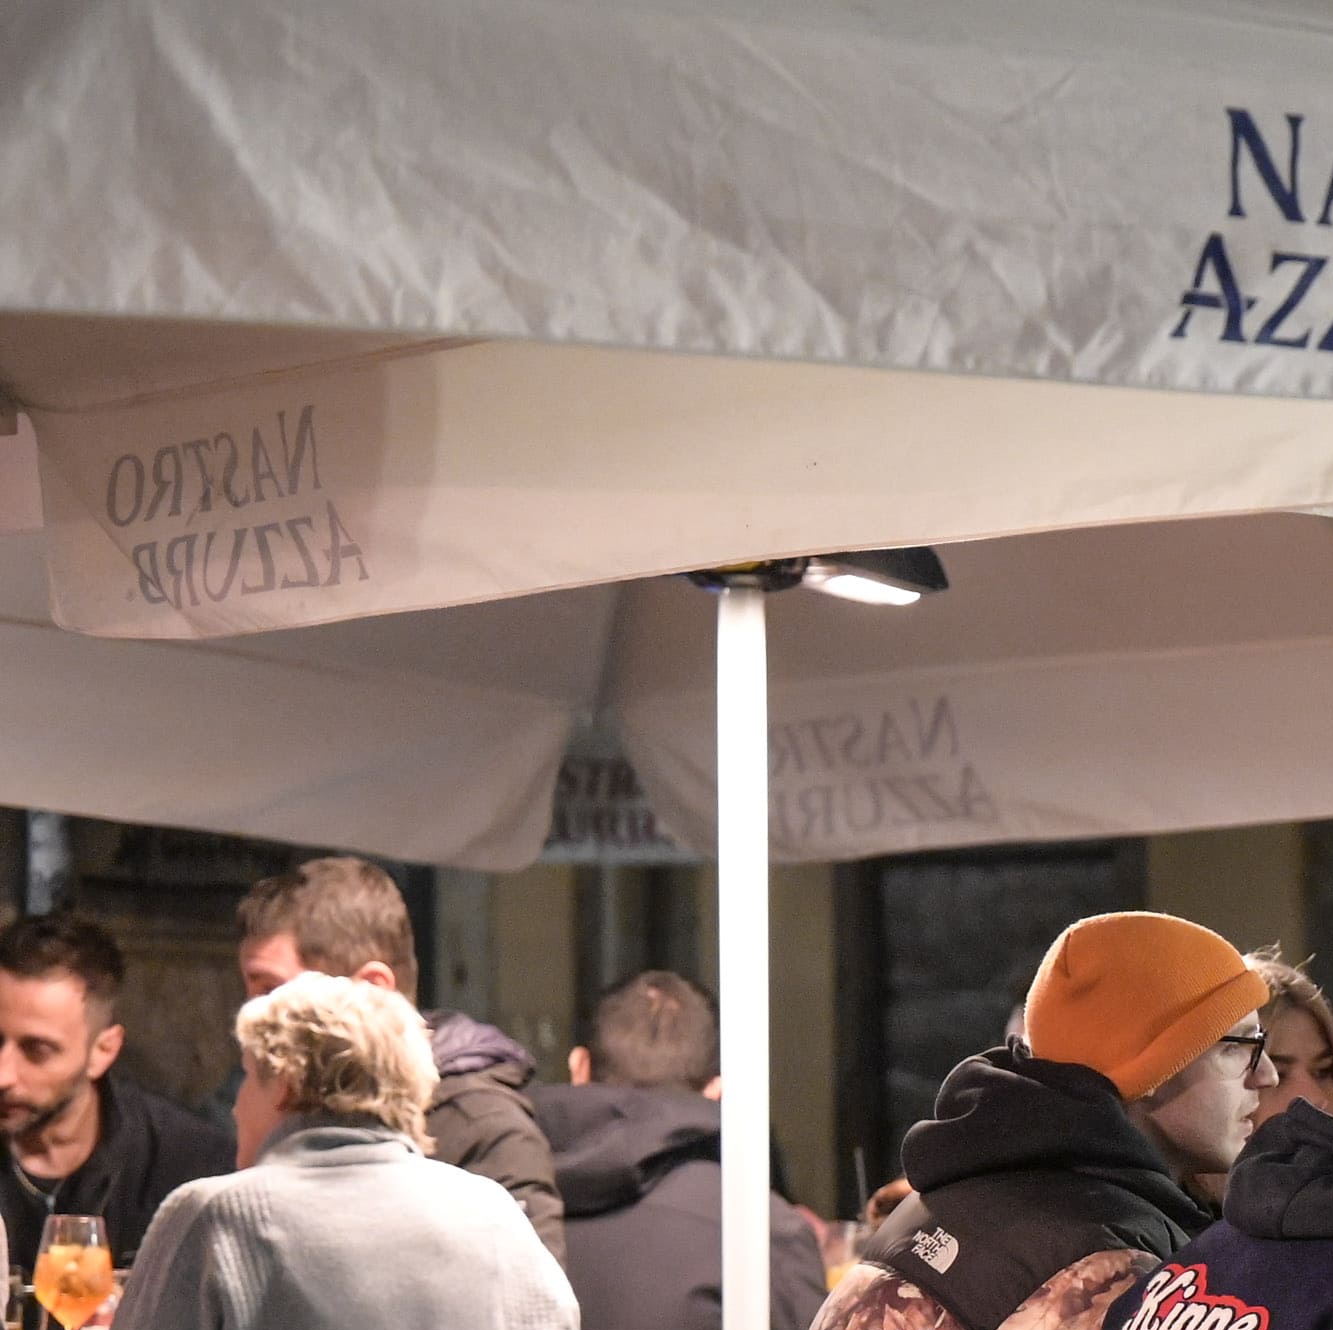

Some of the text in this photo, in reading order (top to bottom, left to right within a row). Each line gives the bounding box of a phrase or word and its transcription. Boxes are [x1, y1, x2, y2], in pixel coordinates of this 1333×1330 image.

[912, 1230, 940, 1253] NORTH
[933, 1226, 951, 1246] THE
[911, 1243, 938, 1262] FACE
